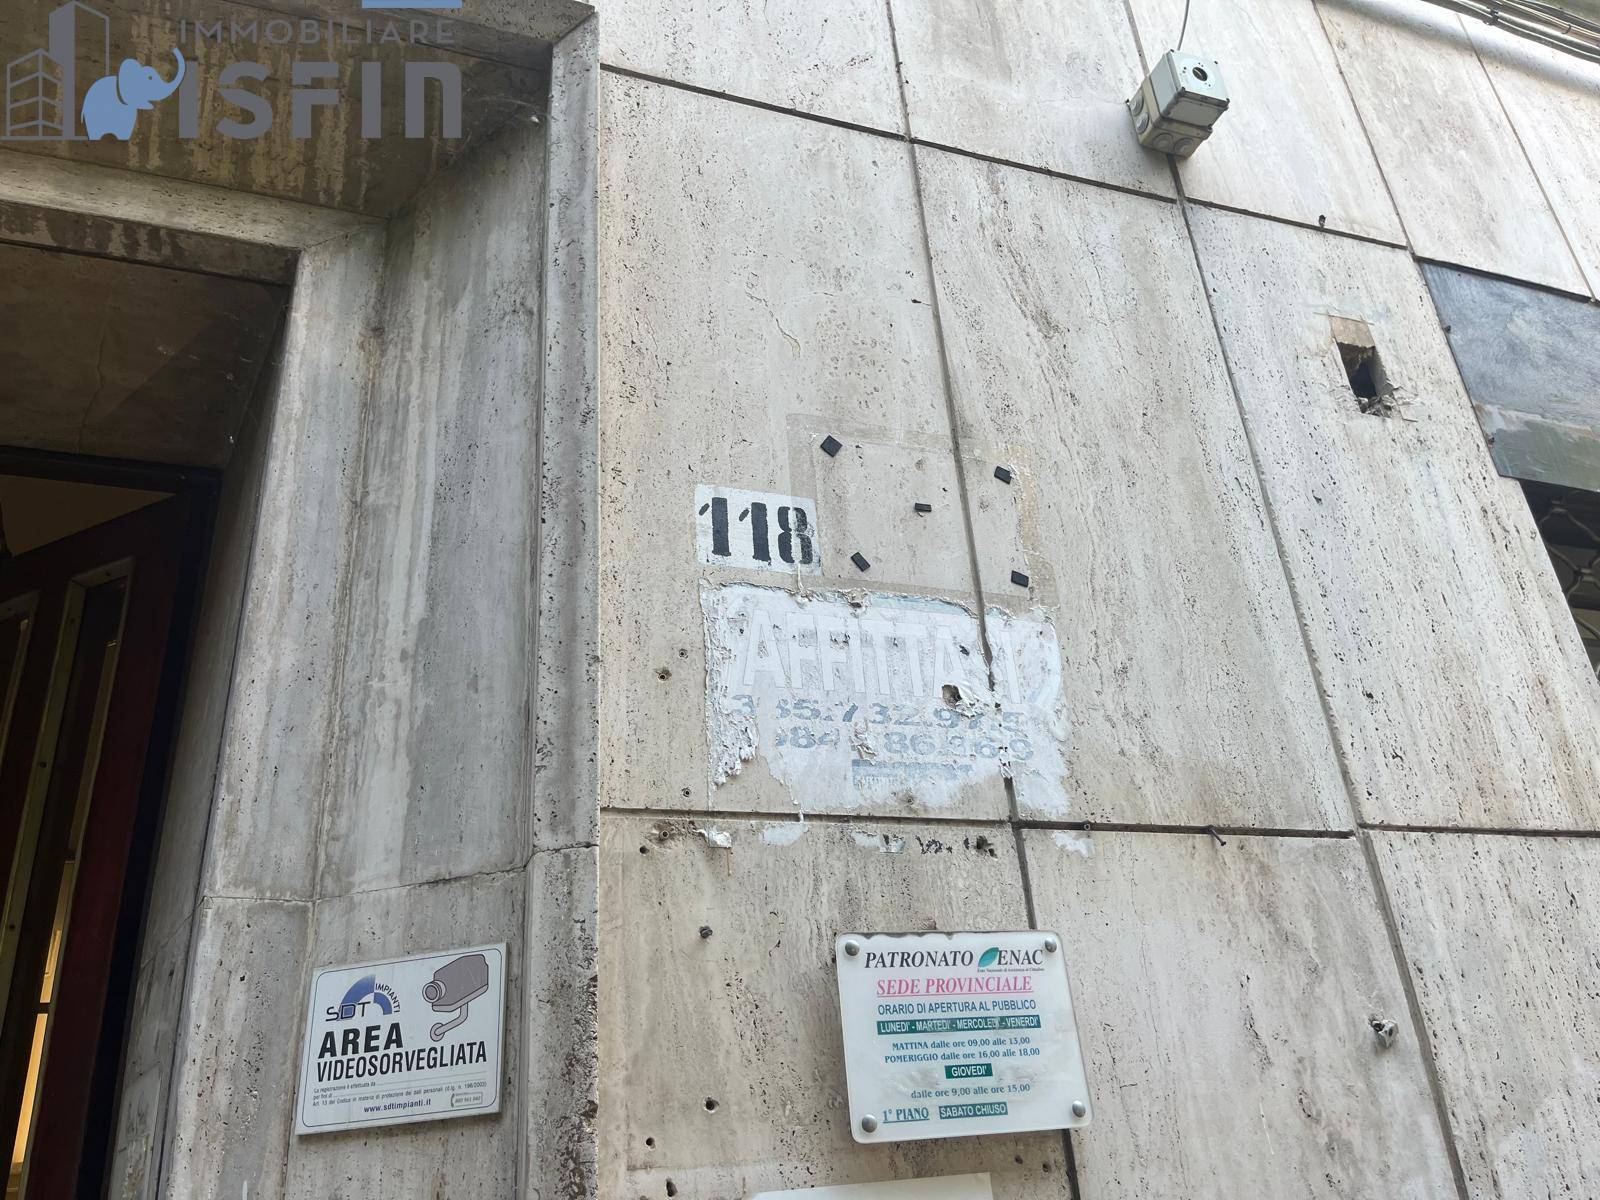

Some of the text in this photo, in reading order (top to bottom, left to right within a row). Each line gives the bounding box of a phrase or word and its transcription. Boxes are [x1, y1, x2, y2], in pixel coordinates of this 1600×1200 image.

[699, 497, 813, 564] 118
[864, 950, 1043, 968] PATRONATO ENAC
[876, 976, 1033, 996] SEDE PROVINCIALE
[375, 983, 401, 1013] IMPIANTI
[325, 1001, 371, 1021] SDT
[877, 999, 1037, 1015] ORARIO DI APERTURA AL PUBBLICO
[318, 1022, 404, 1059] AREA
[892, 1041, 928, 1051] MATTINA
[930, 1041, 950, 1049] dalle
[967, 1038, 990, 1048] 09,00
[992, 1037, 1006, 1046] alle
[1008, 1037, 1030, 1046] 13,00
[317, 1041, 487, 1082] VIDEOSORVEGLIATA
[884, 1053, 938, 1064] POMERIGGIO
[940, 1052, 960, 1061] dalle
[978, 1050, 1000, 1060] 16,00
[1002, 1049, 1017, 1058] alle
[1018, 1048, 1040, 1057] 18,00
[951, 1065, 987, 1077] GIOVEDI'
[911, 1084, 1031, 1099] dalle ore 9,00 alle ore 15,00
[363, 1098, 431, 1113] www.sdtimpianti.it
[896, 1106, 929, 1120] PIANO
[940, 1106, 973, 1118] SABATO
[975, 1103, 1006, 1115] CHIUSO
